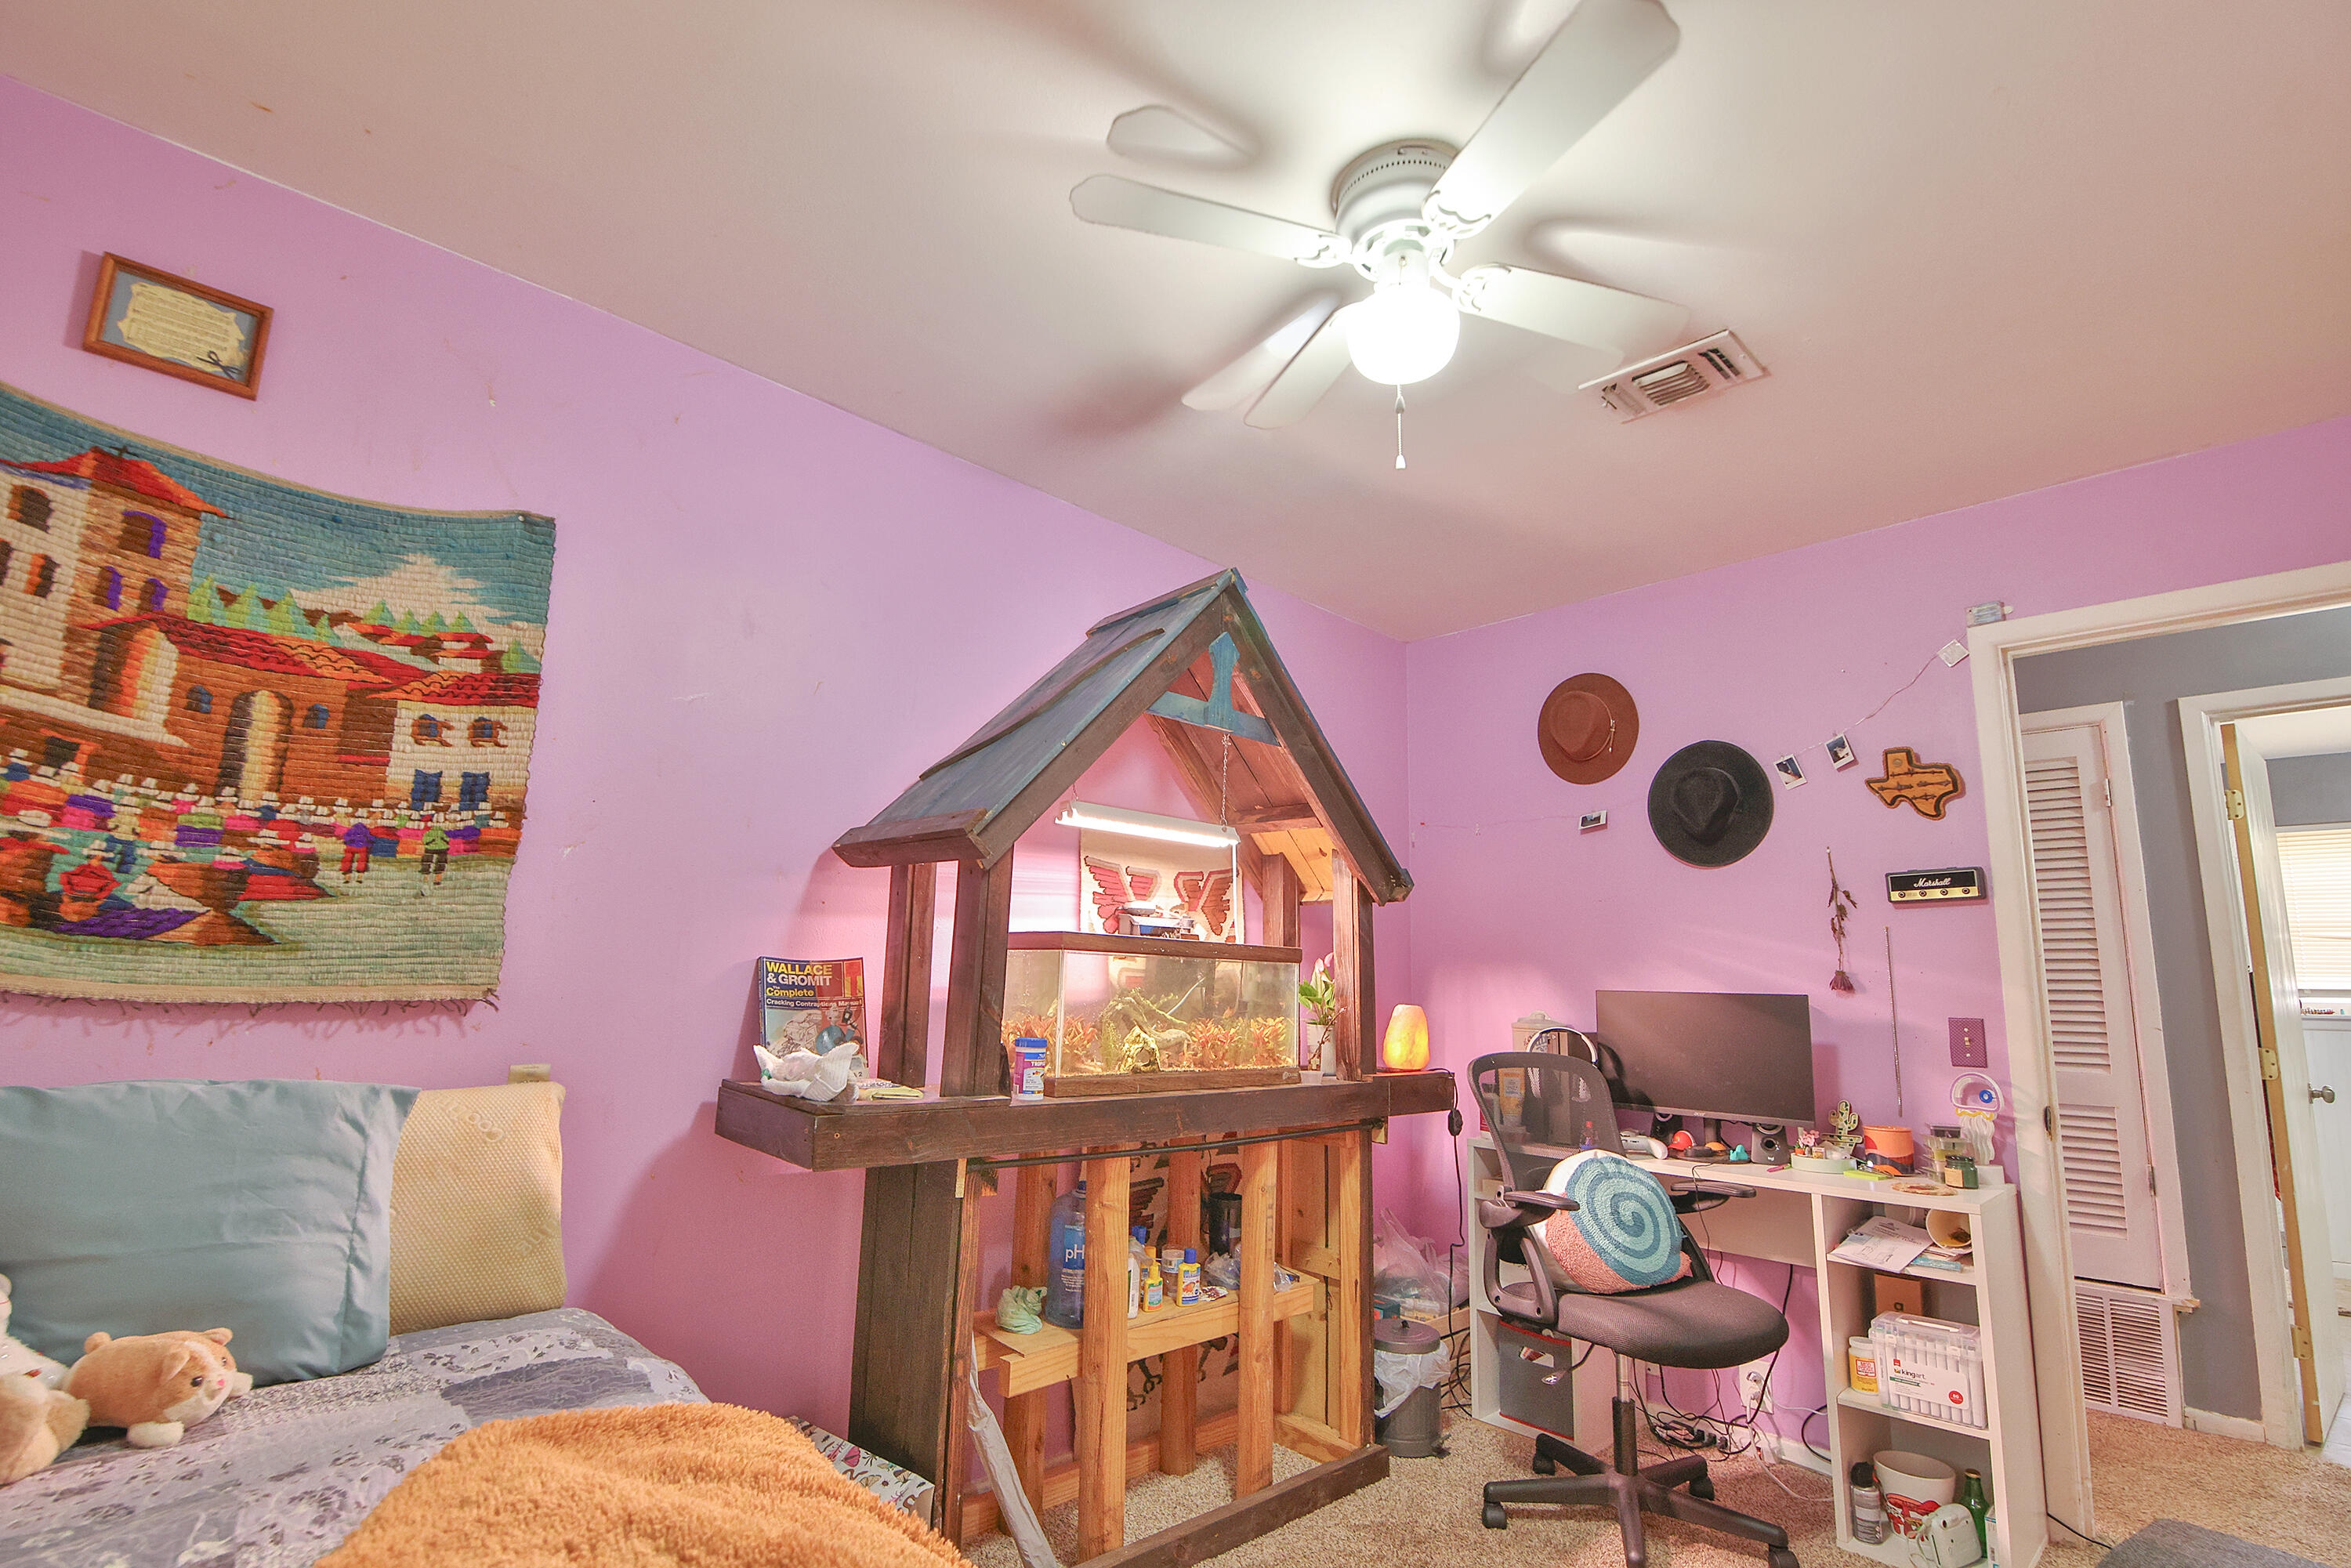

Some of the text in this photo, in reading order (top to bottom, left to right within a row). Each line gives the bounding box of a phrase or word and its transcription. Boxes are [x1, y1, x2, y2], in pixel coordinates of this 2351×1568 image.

[1913, 877, 1951, 888] Marshall
[766, 961, 832, 976] WALLACE
[766, 972, 832, 986] & GROMIT
[766, 987, 815, 998] Complete
[766, 998, 795, 1007] Cracking
[1065, 1244, 1085, 1263] pH
